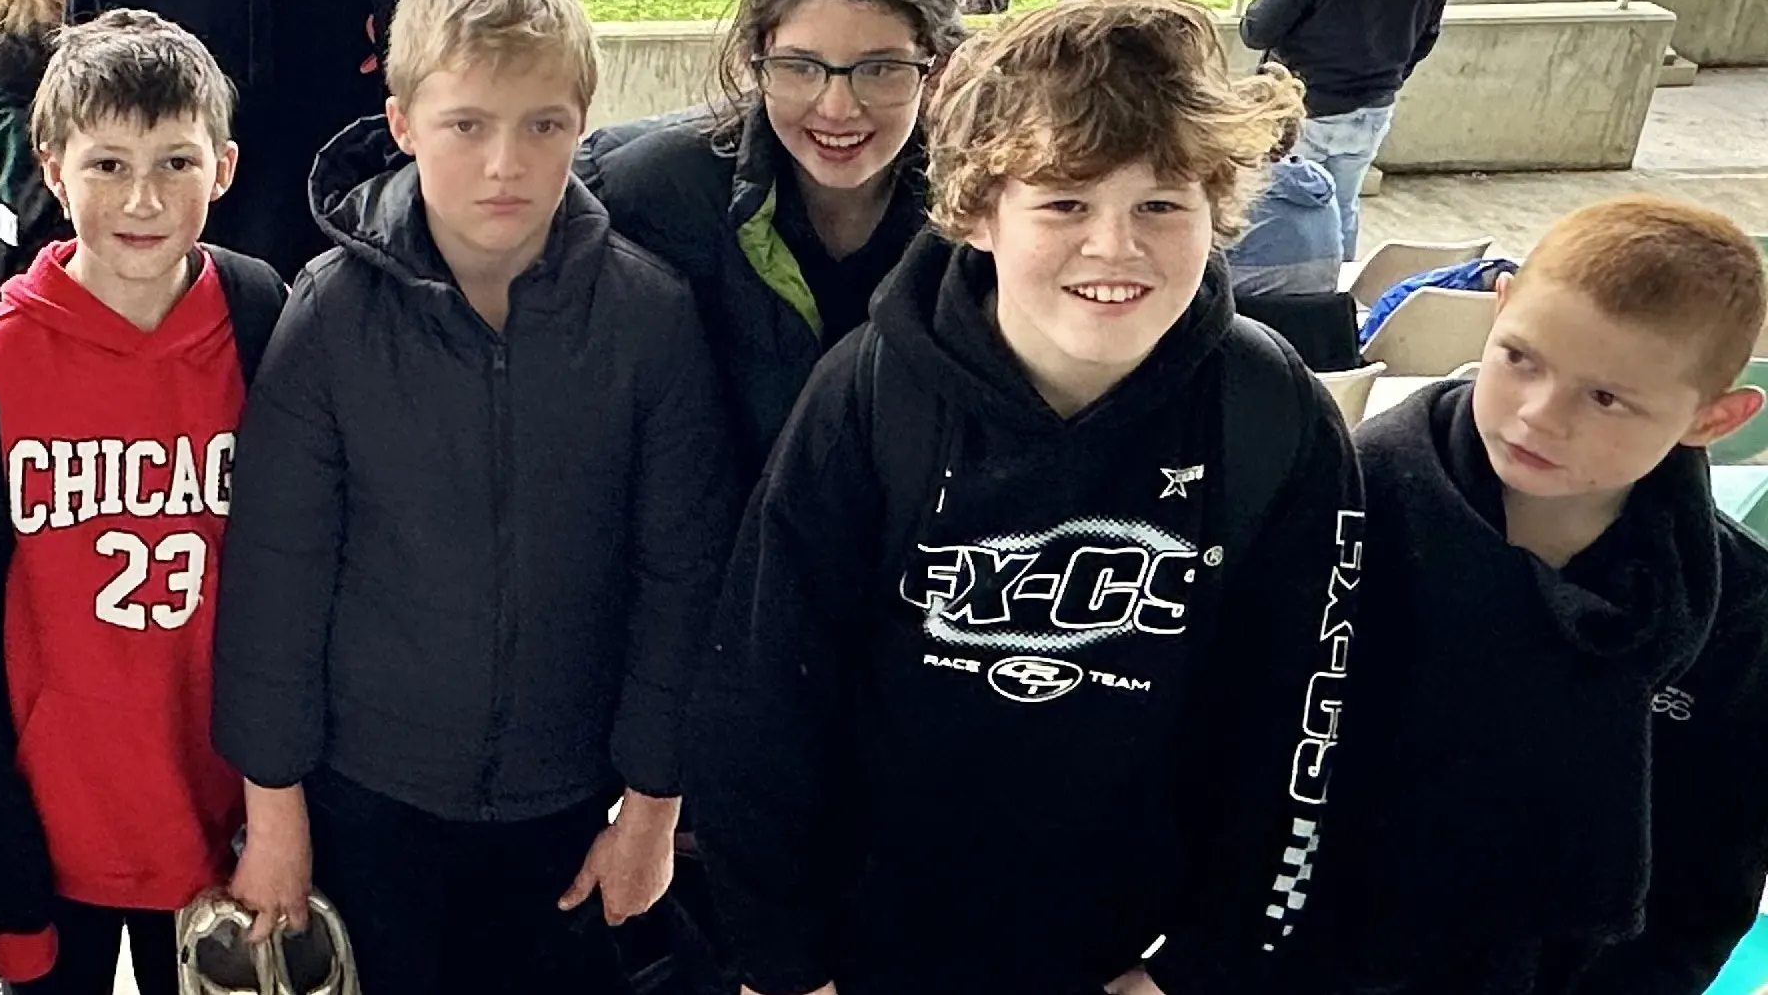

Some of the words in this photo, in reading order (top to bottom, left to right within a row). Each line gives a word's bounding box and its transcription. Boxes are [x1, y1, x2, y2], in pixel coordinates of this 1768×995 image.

[8, 432, 237, 535] CHICAG
[95, 531, 207, 631] 23
[923, 654, 981, 673] RACE
[1089, 670, 1152, 693] TEAM
